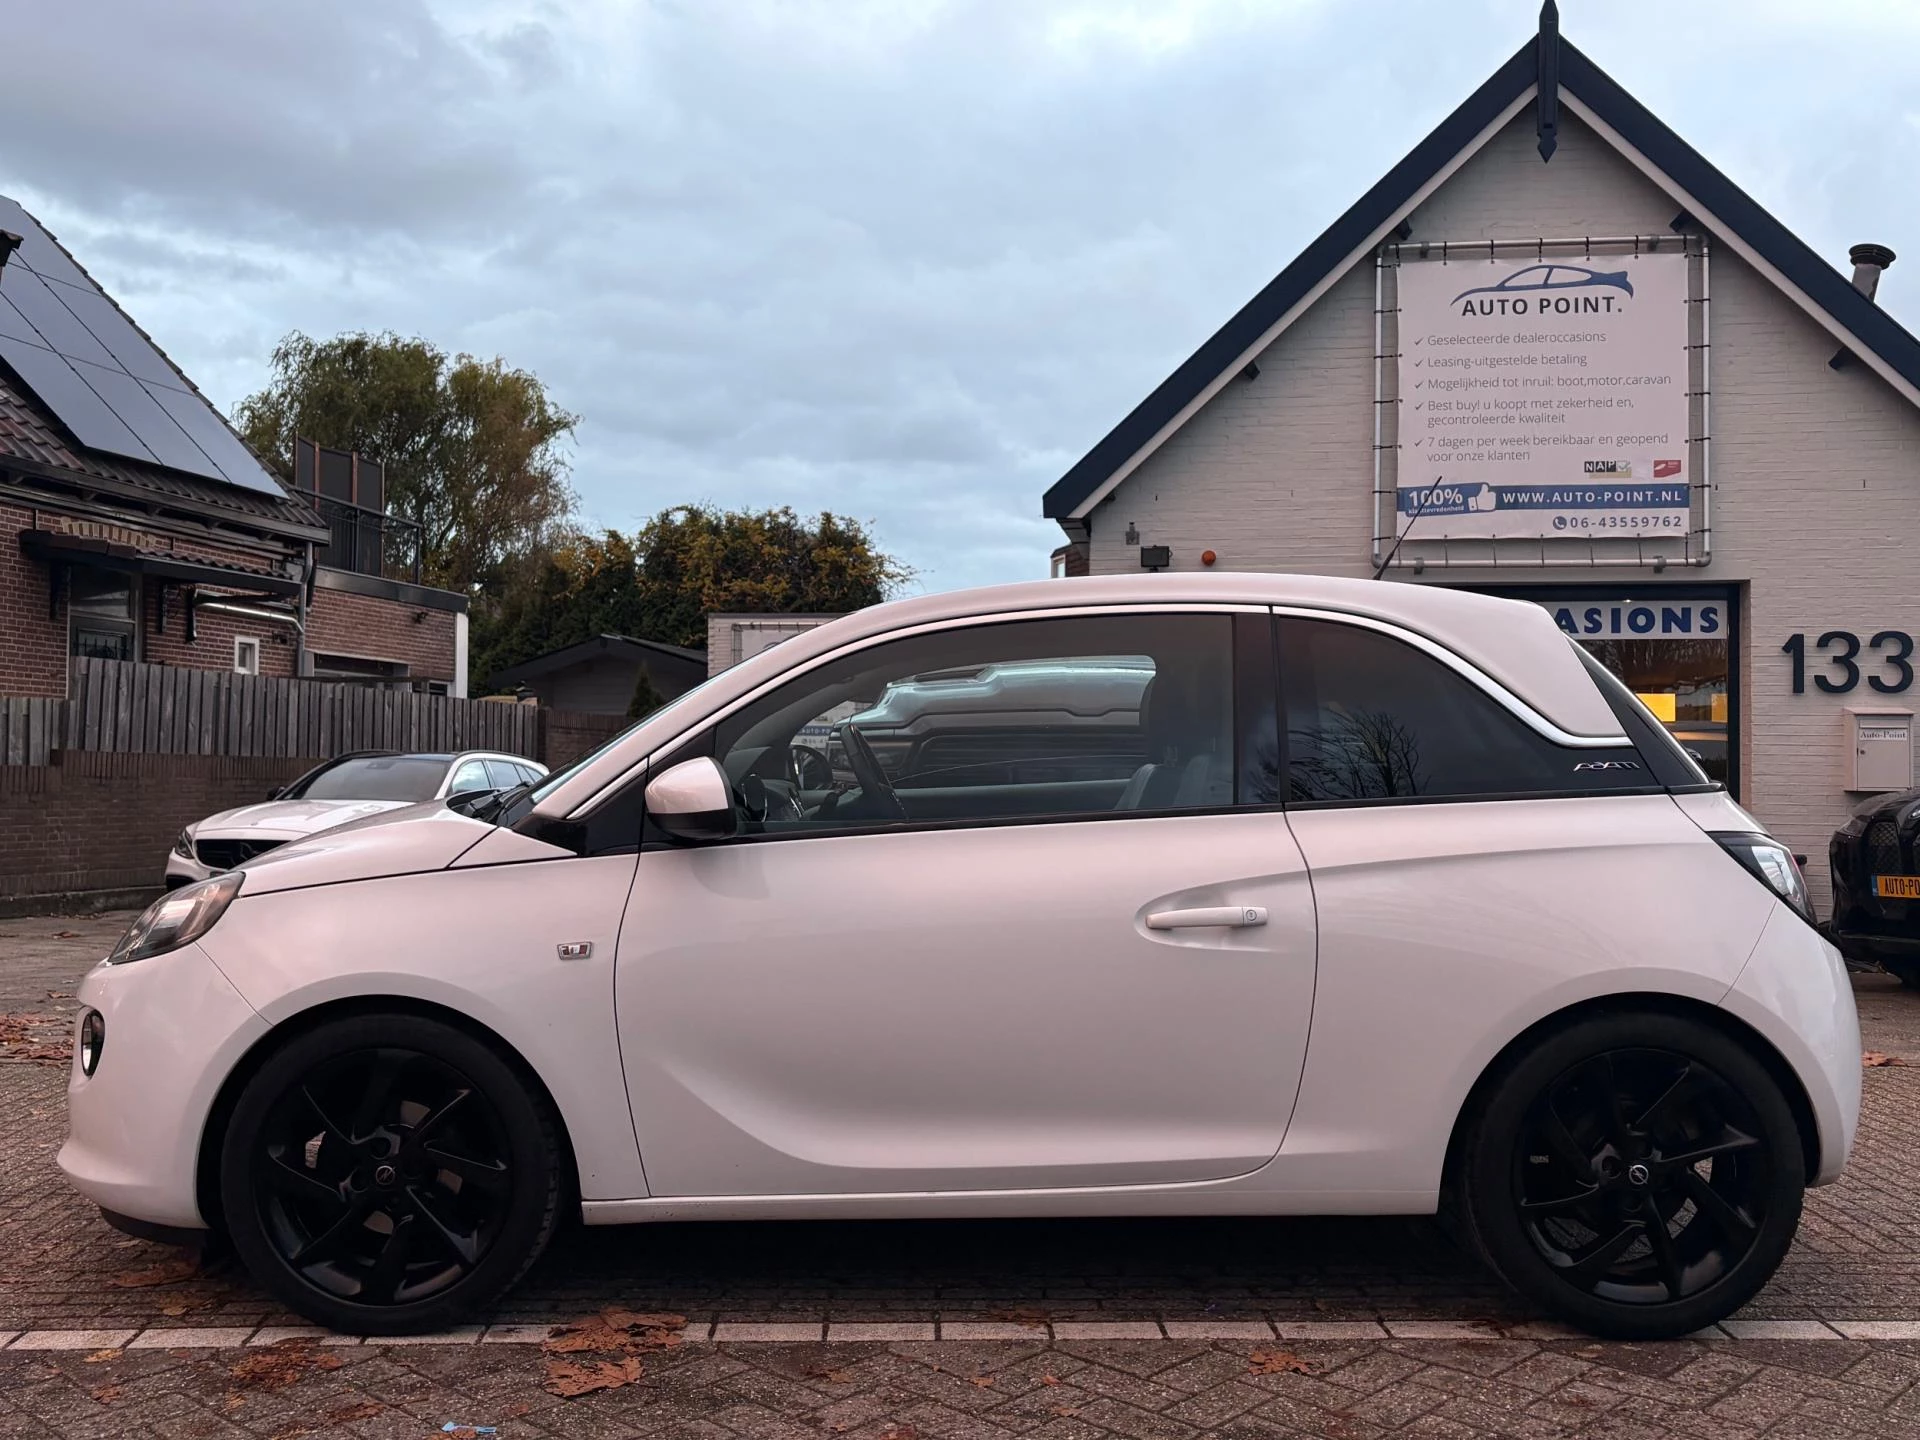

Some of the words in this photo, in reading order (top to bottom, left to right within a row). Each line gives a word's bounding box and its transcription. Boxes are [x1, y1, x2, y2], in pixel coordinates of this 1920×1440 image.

[1461, 298, 1528, 316] AUTO
[1427, 334, 1510, 346] Geselecteerde
[1513, 331, 1607, 344] dealeroccasions
[1427, 355, 1538, 369] Leasing-uitgestelde
[1541, 353, 1588, 367] betaling
[1428, 377, 1499, 391] Mogelijkheid
[1502, 377, 1519, 387] tot
[1522, 376, 1554, 387] inruil:
[1428, 400, 1453, 411] Best
[1456, 399, 1480, 413] buy!
[1483, 401, 1491, 409] u
[1494, 398, 1527, 411] koopt
[1531, 399, 1553, 409] met
[1557, 397, 1613, 408] zekerheid
[1616, 399, 1634, 409] en,
[1427, 413, 1515, 428] gecontroleerde
[1519, 412, 1565, 424] kwaliteit
[1427, 437, 1435, 447] 7
[1438, 436, 1473, 450] dagen
[1477, 437, 1496, 448] per
[1499, 435, 1530, 446] week
[1533, 434, 1595, 445] bereikbaar
[1598, 435, 1613, 445] en
[1616, 433, 1668, 448] geopend
[1427, 453, 1453, 462] voor
[1456, 452, 1484, 461] onze
[1487, 450, 1530, 461] klanten
[1584, 461, 1617, 473] NAP
[1409, 488, 1463, 507] 100%
[1502, 490, 1682, 504] WWW.AUTO-POINT.NL
[1570, 516, 1682, 528] 06-43559762
[1782, 630, 1914, 694] 133
[1860, 730, 1906, 739] Auto-Point
